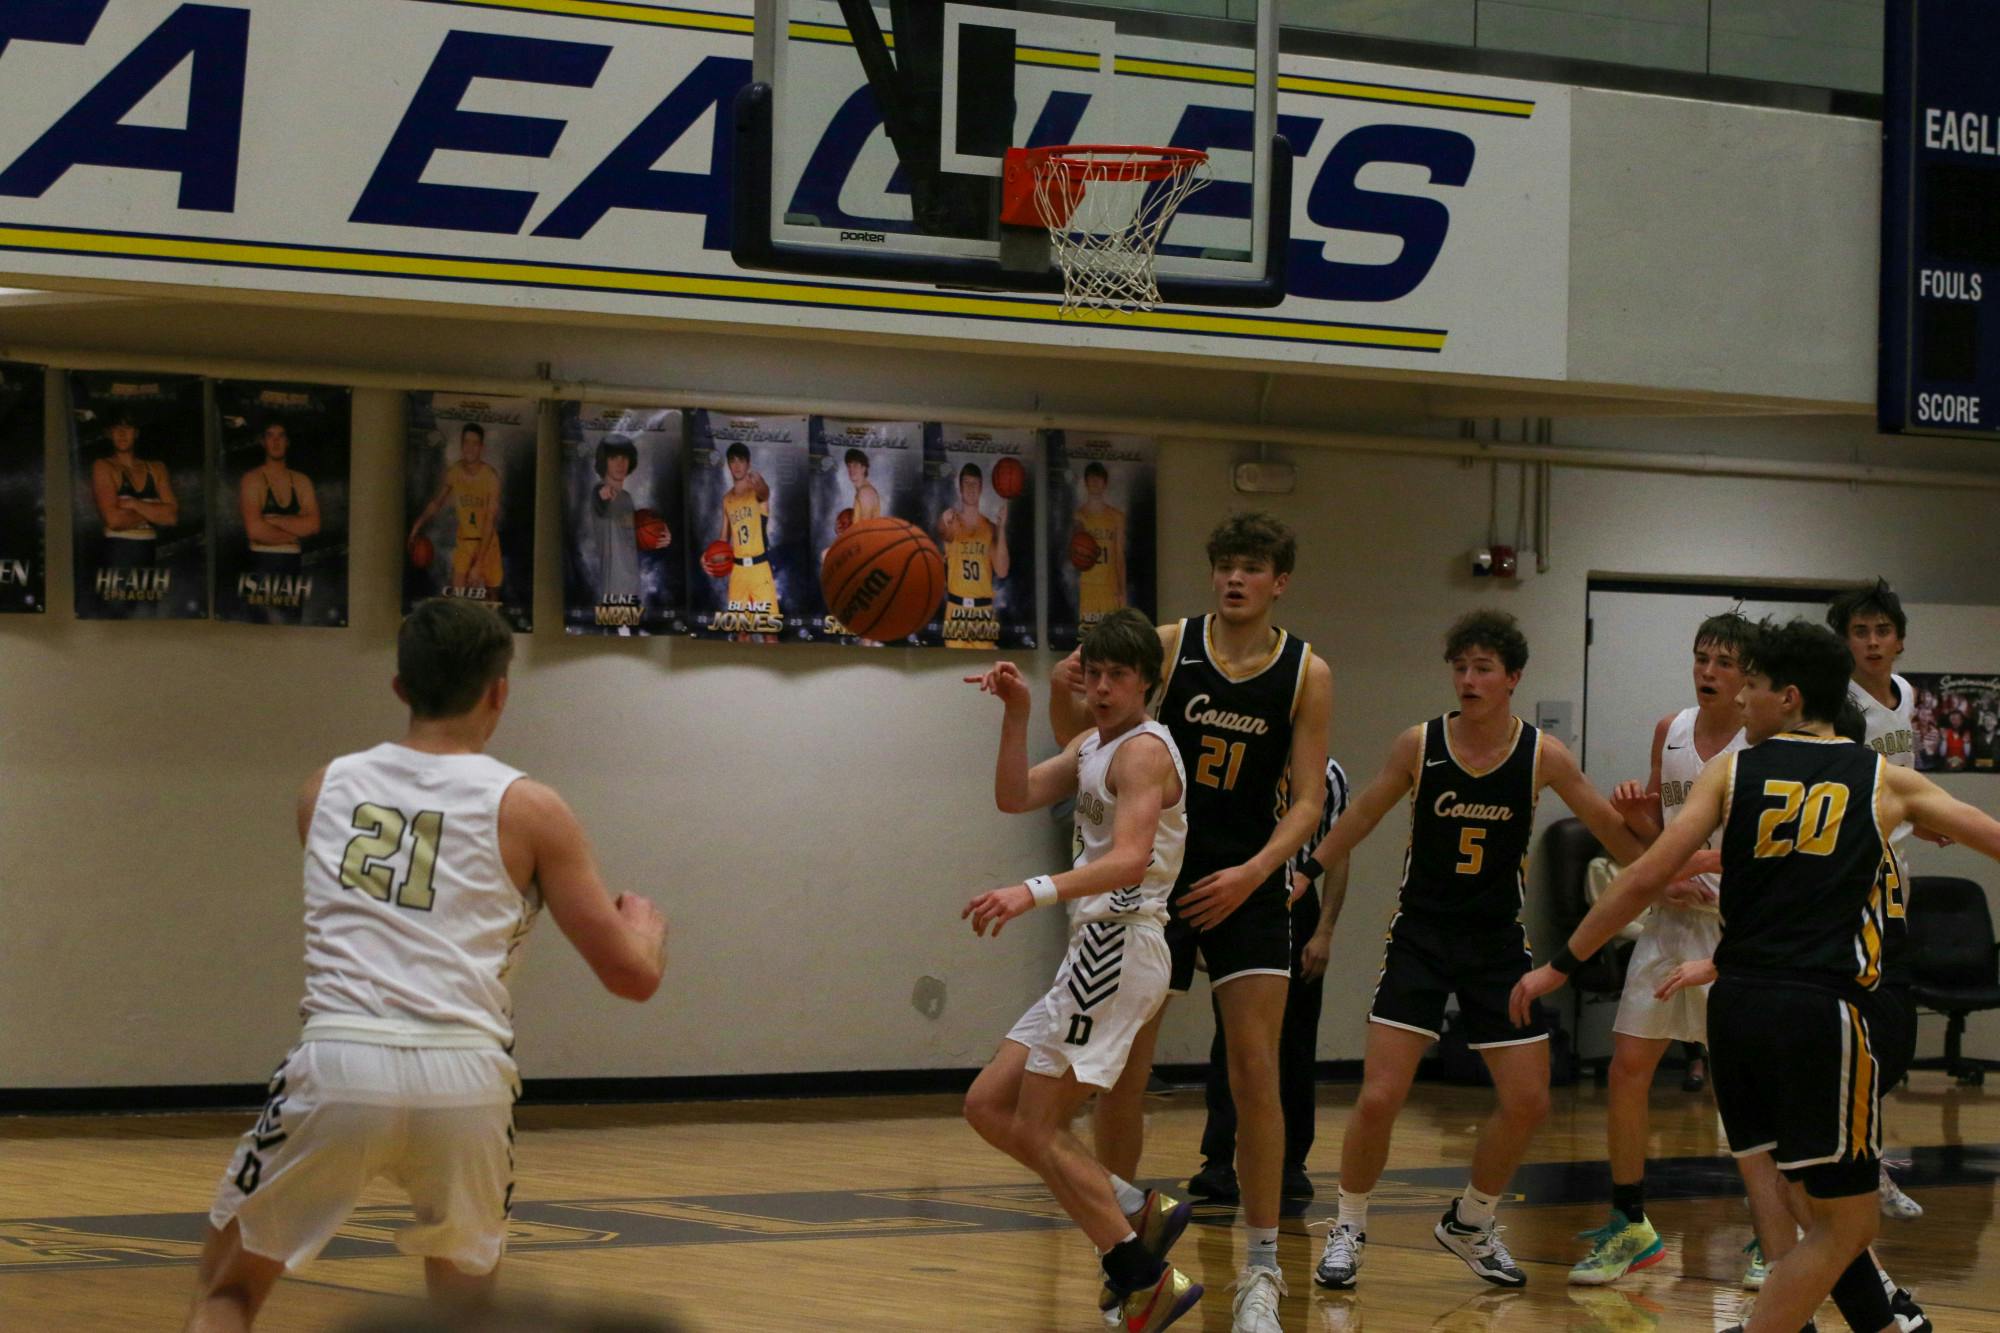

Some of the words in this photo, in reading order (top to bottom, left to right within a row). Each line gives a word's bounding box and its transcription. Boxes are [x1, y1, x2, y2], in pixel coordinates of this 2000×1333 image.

[1925, 108, 2000, 155] EAGL
[348, 30, 1476, 302] EAGLES
[1920, 270, 1983, 301] FOULS
[1918, 393, 1980, 424] SCORE
[737, 525, 750, 545] 13
[96, 566, 172, 592] HEATH
[963, 560, 980, 581] 50
[237, 572, 313, 600] ISAIAH
[440, 586, 488, 599] CALEB
[602, 593, 636, 605] LUKE
[594, 605, 645, 625] WRAY
[727, 601, 772, 612] BLAKE
[951, 608, 992, 620] DYLAN
[707, 611, 785, 633] JONES
[942, 620, 1001, 640] MANOR
[1184, 693, 1268, 736] Cowan
[1195, 736, 1247, 791] 21
[1434, 790, 1514, 822] Cowan
[1754, 779, 1851, 860] 20
[338, 801, 444, 911] 21
[1455, 827, 1487, 875] 5
[1069, 1013, 1094, 1046] D
